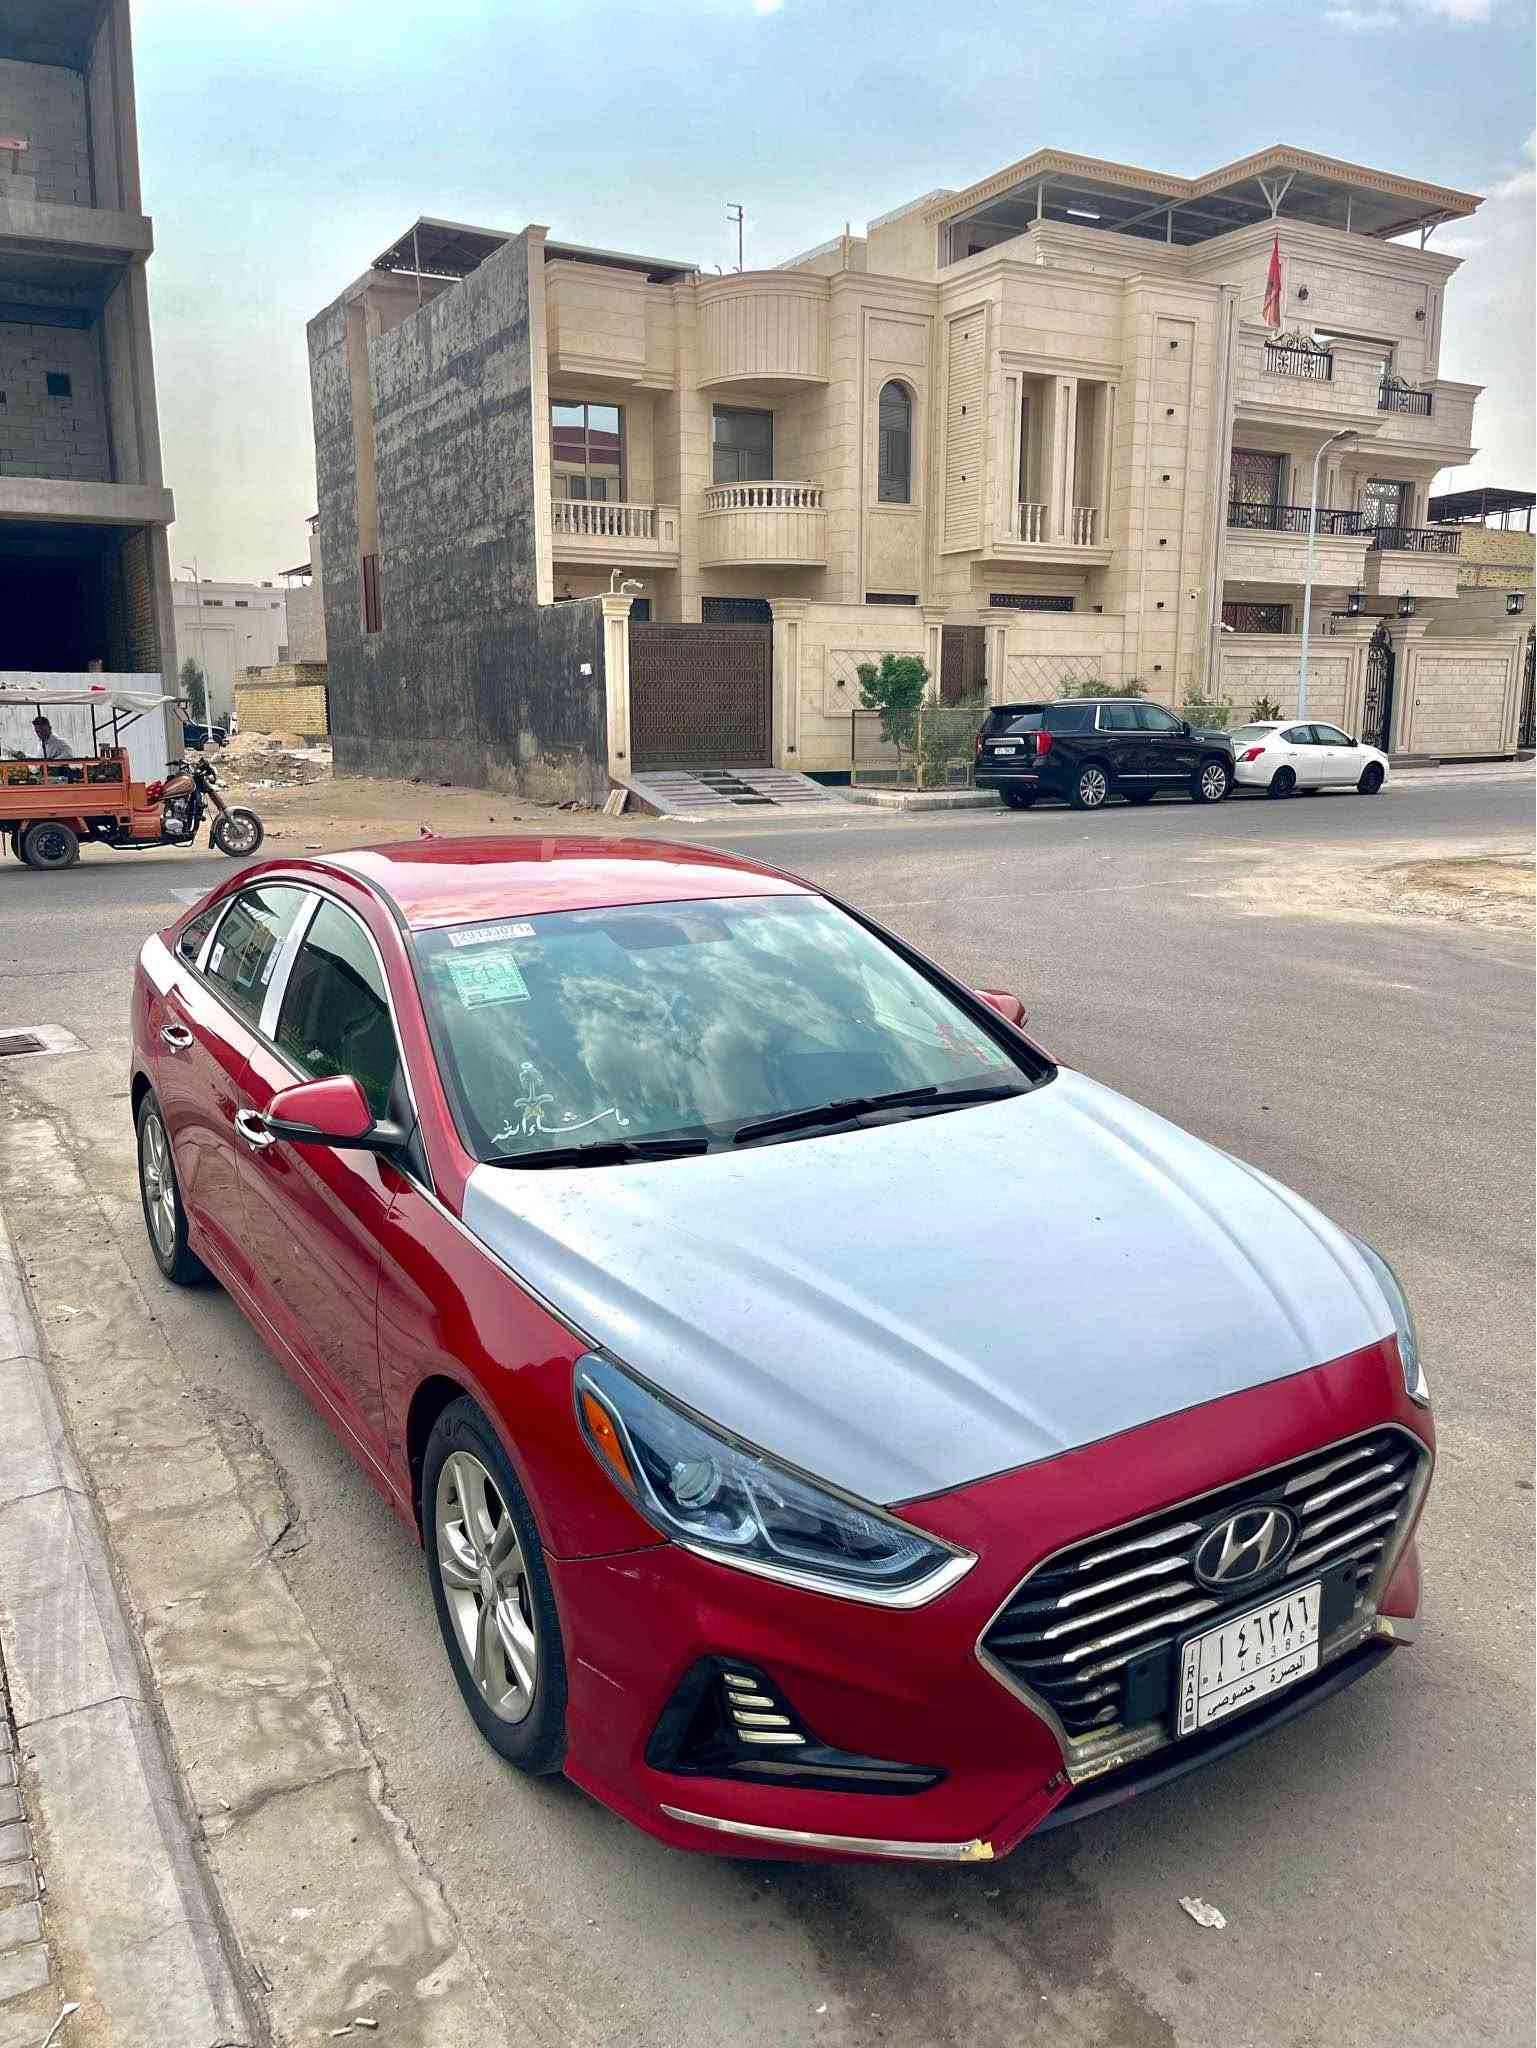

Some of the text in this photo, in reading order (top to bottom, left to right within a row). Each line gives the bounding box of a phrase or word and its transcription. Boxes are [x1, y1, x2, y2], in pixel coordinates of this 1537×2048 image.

[1184, 1649, 1196, 1713] IRAQ
[1208, 1655, 1306, 1716] البصرة خصوصي
